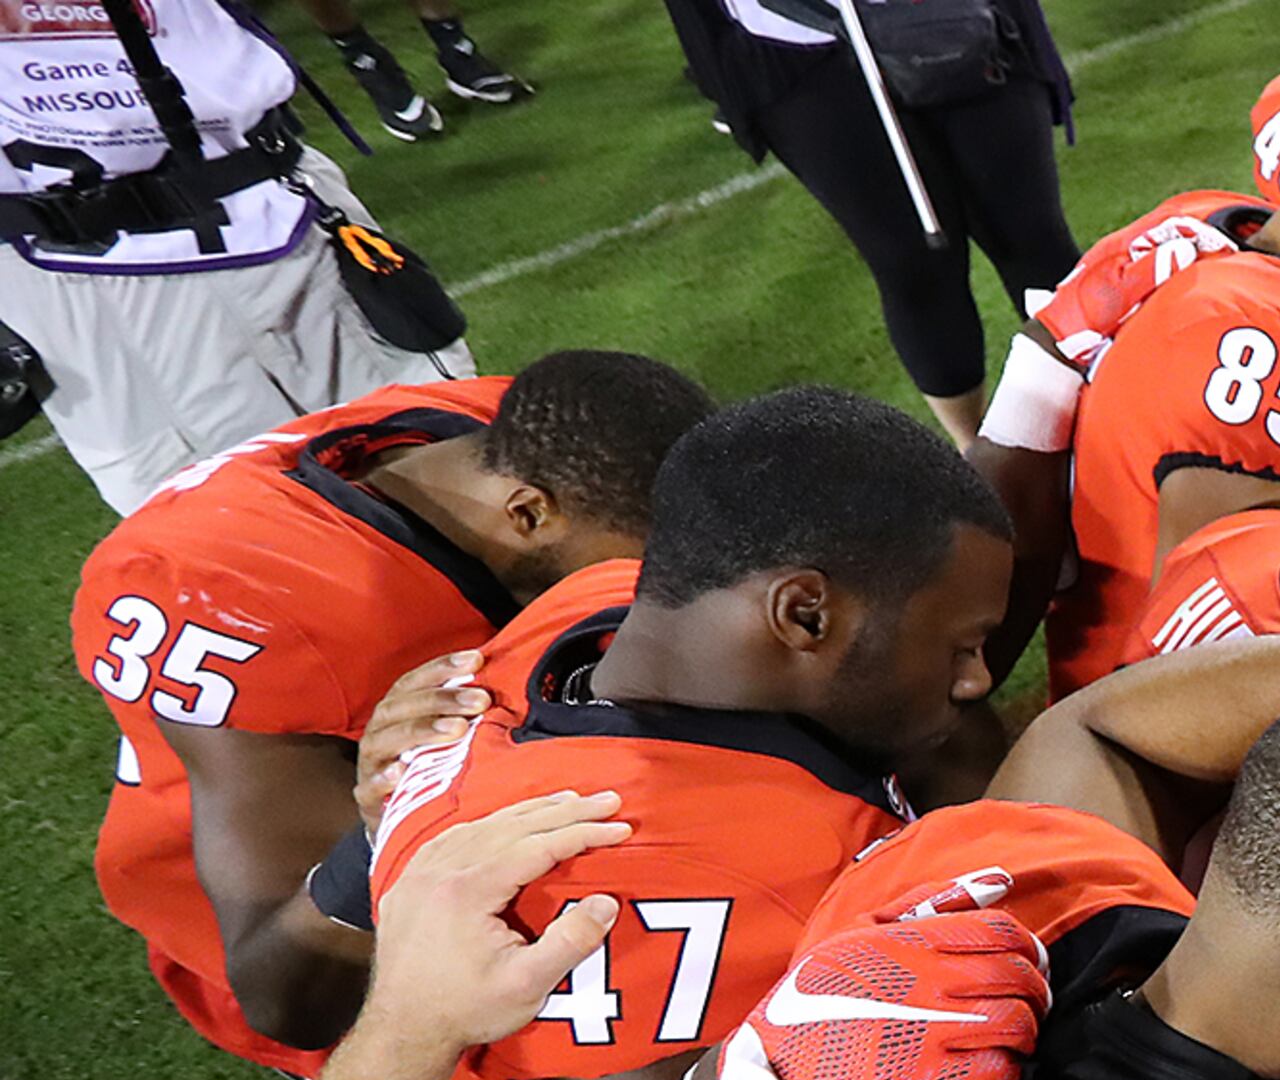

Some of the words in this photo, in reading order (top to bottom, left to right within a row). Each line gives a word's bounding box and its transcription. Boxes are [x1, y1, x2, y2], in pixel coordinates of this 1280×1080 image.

[20, 3, 110, 23] GEORG
[22, 61, 109, 81] Game
[21, 88, 150, 113] MISSOU
[92, 594, 264, 729] 35
[535, 897, 735, 1046] 47
